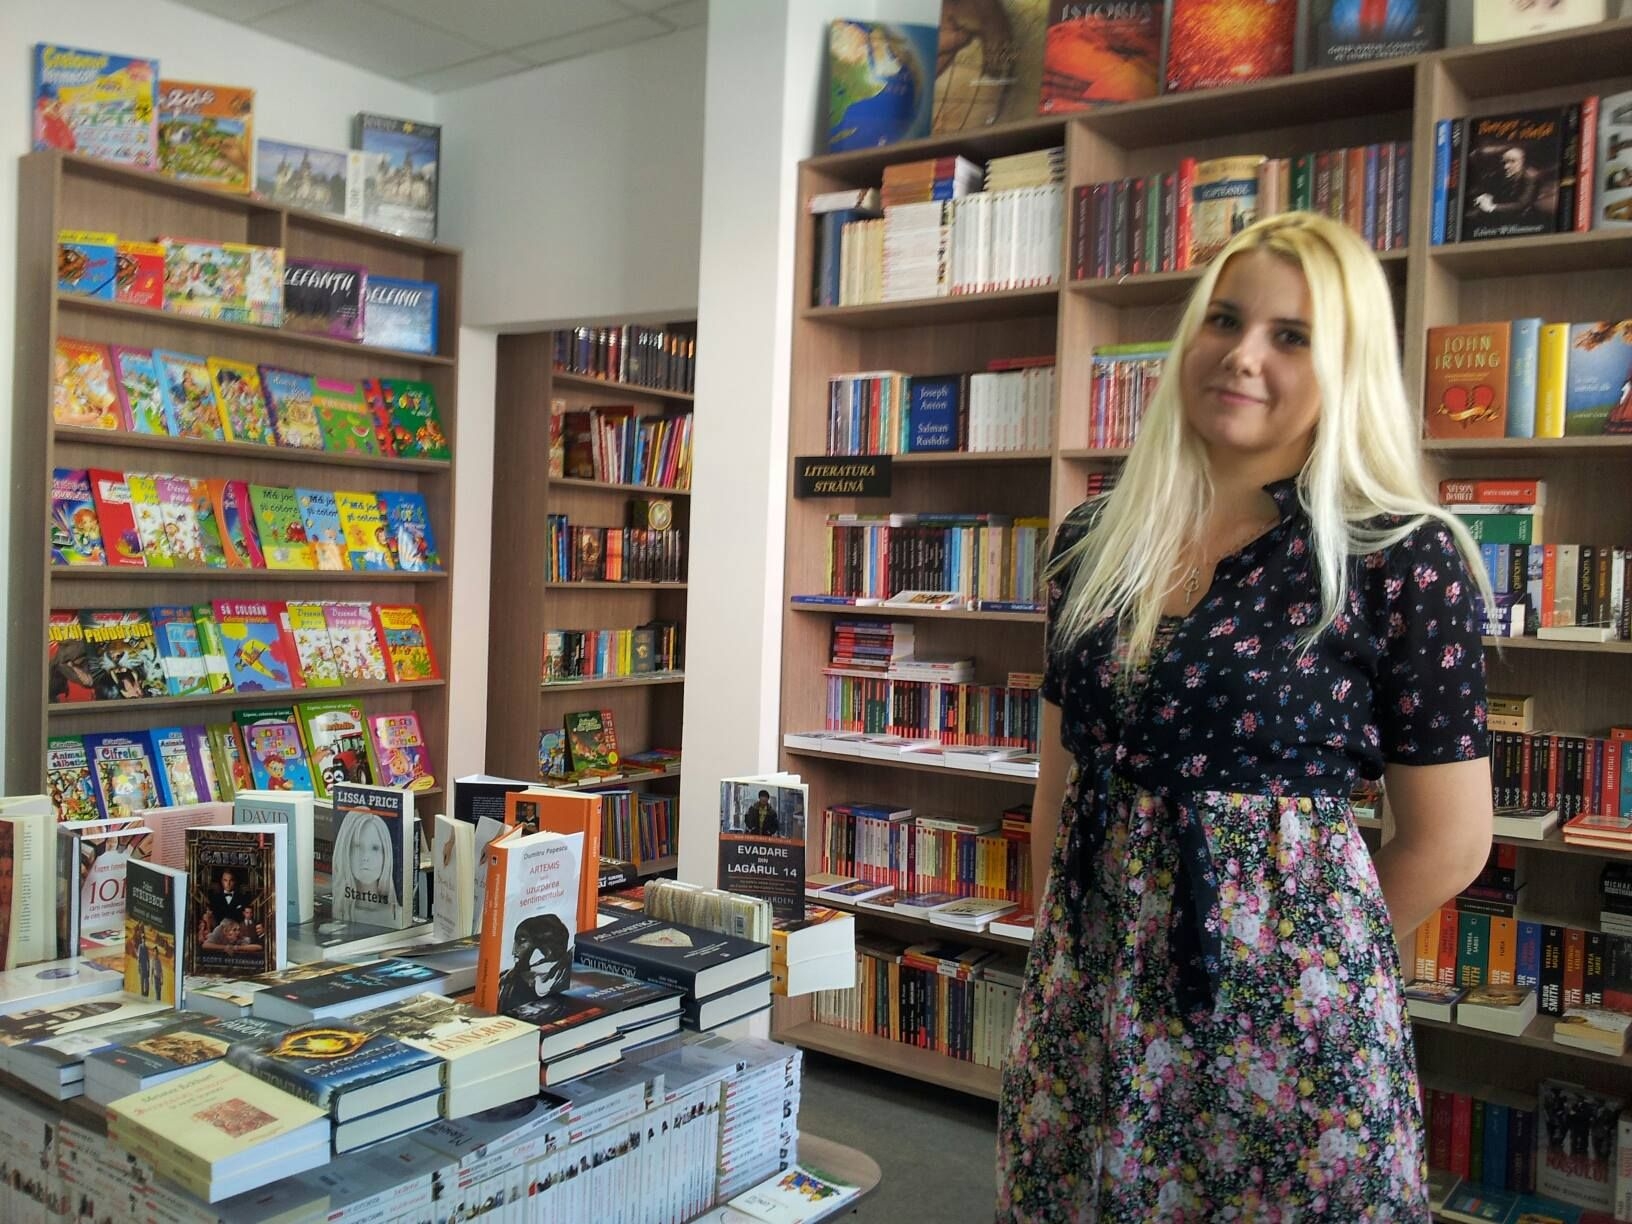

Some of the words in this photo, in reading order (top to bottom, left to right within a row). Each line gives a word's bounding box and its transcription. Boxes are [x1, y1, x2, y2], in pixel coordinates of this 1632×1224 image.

[283, 267, 356, 300] LEFANȚII
[1443, 336, 1492, 354] JOHN
[1434, 352, 1501, 370] IRVING
[920, 386, 948, 400] Joseph
[920, 400, 947, 411] Anton
[918, 423, 948, 434] Salman
[917, 435, 950, 447] Rushdie
[323, 496, 336, 506] jo
[101, 746, 138, 762] Cifrele
[336, 790, 366, 806] LISSA
[368, 793, 399, 809] PRICE
[242, 808, 289, 825] DAVID
[523, 849, 546, 861] Dumitru
[546, 845, 569, 857] Popescu
[737, 845, 788, 858] EVADARE
[529, 861, 561, 875] ARTEMIS
[727, 863, 779, 876] LAGĂRUL
[783, 868, 797, 878] 14
[90, 877, 127, 905] 101
[525, 880, 561, 896] uzurparea
[1603, 880, 1632, 891] MICHAE
[345, 886, 389, 905] Starters
[519, 890, 567, 908] sentimentului
[1542, 984, 1550, 1009] WILBUR
[1548, 984, 1559, 1013] SMITH
[429, 1020, 518, 1052] LENINGRAD
